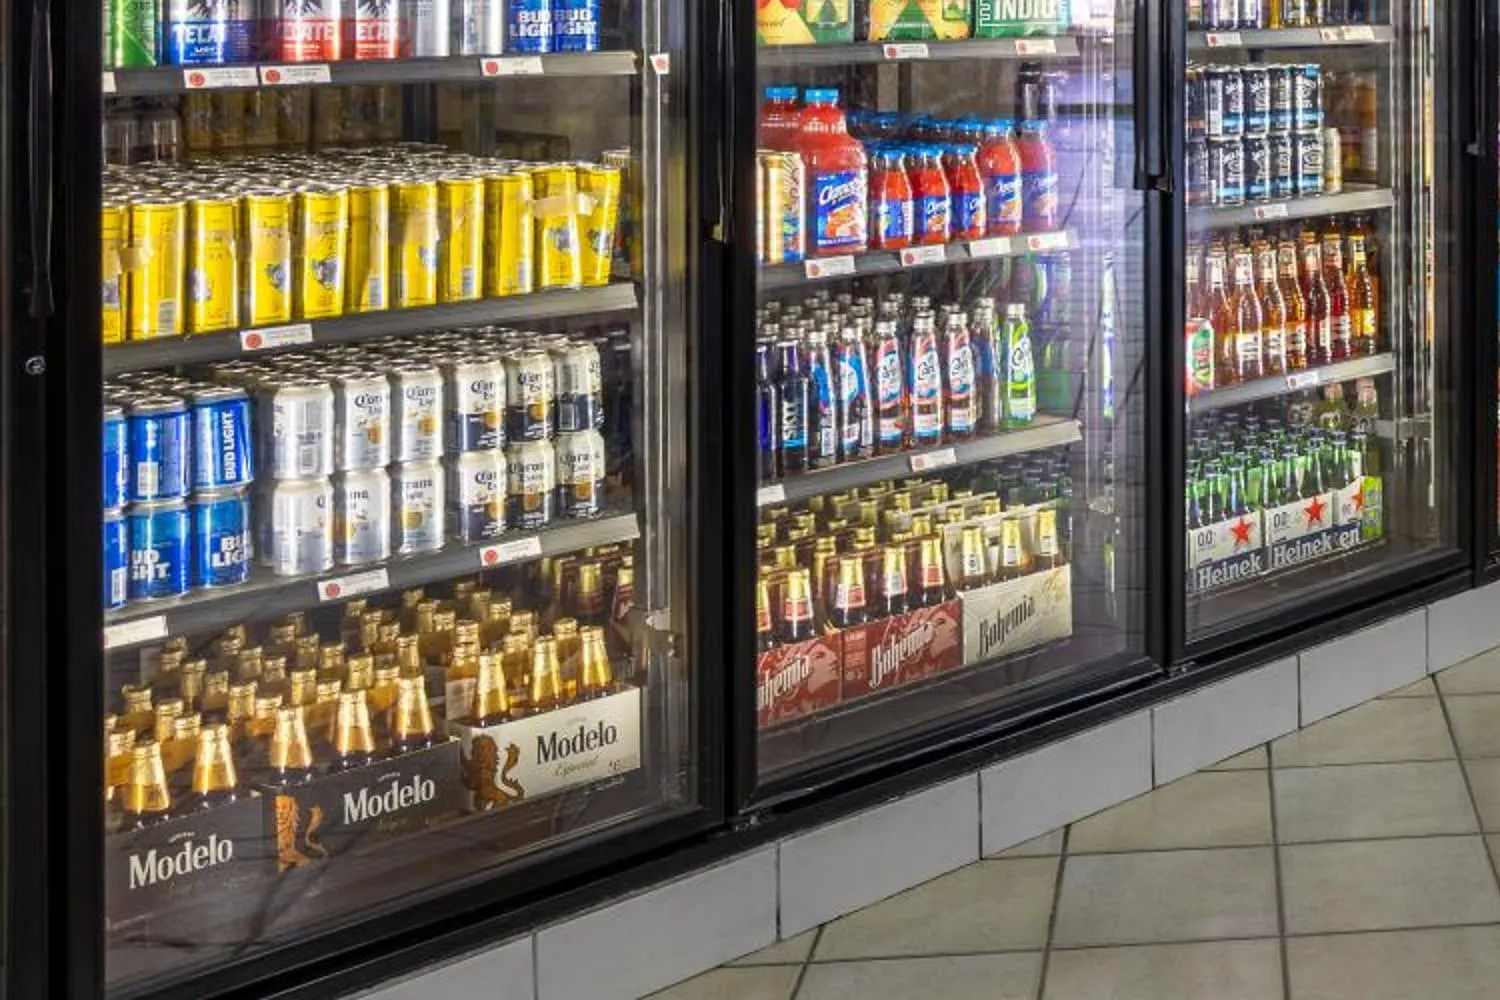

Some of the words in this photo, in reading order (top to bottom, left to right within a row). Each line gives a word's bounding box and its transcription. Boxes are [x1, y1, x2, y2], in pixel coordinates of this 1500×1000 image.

[222, 410, 235, 450] LIGHT
[224, 451, 236, 481] BUD
[979, 595, 1036, 658] Bohemia
[868, 620, 934, 688] Bohemia
[757, 654, 810, 712] ohemia
[537, 721, 617, 765] Modelo
[343, 774, 435, 825] Modelo
[129, 834, 233, 889] Modelo
